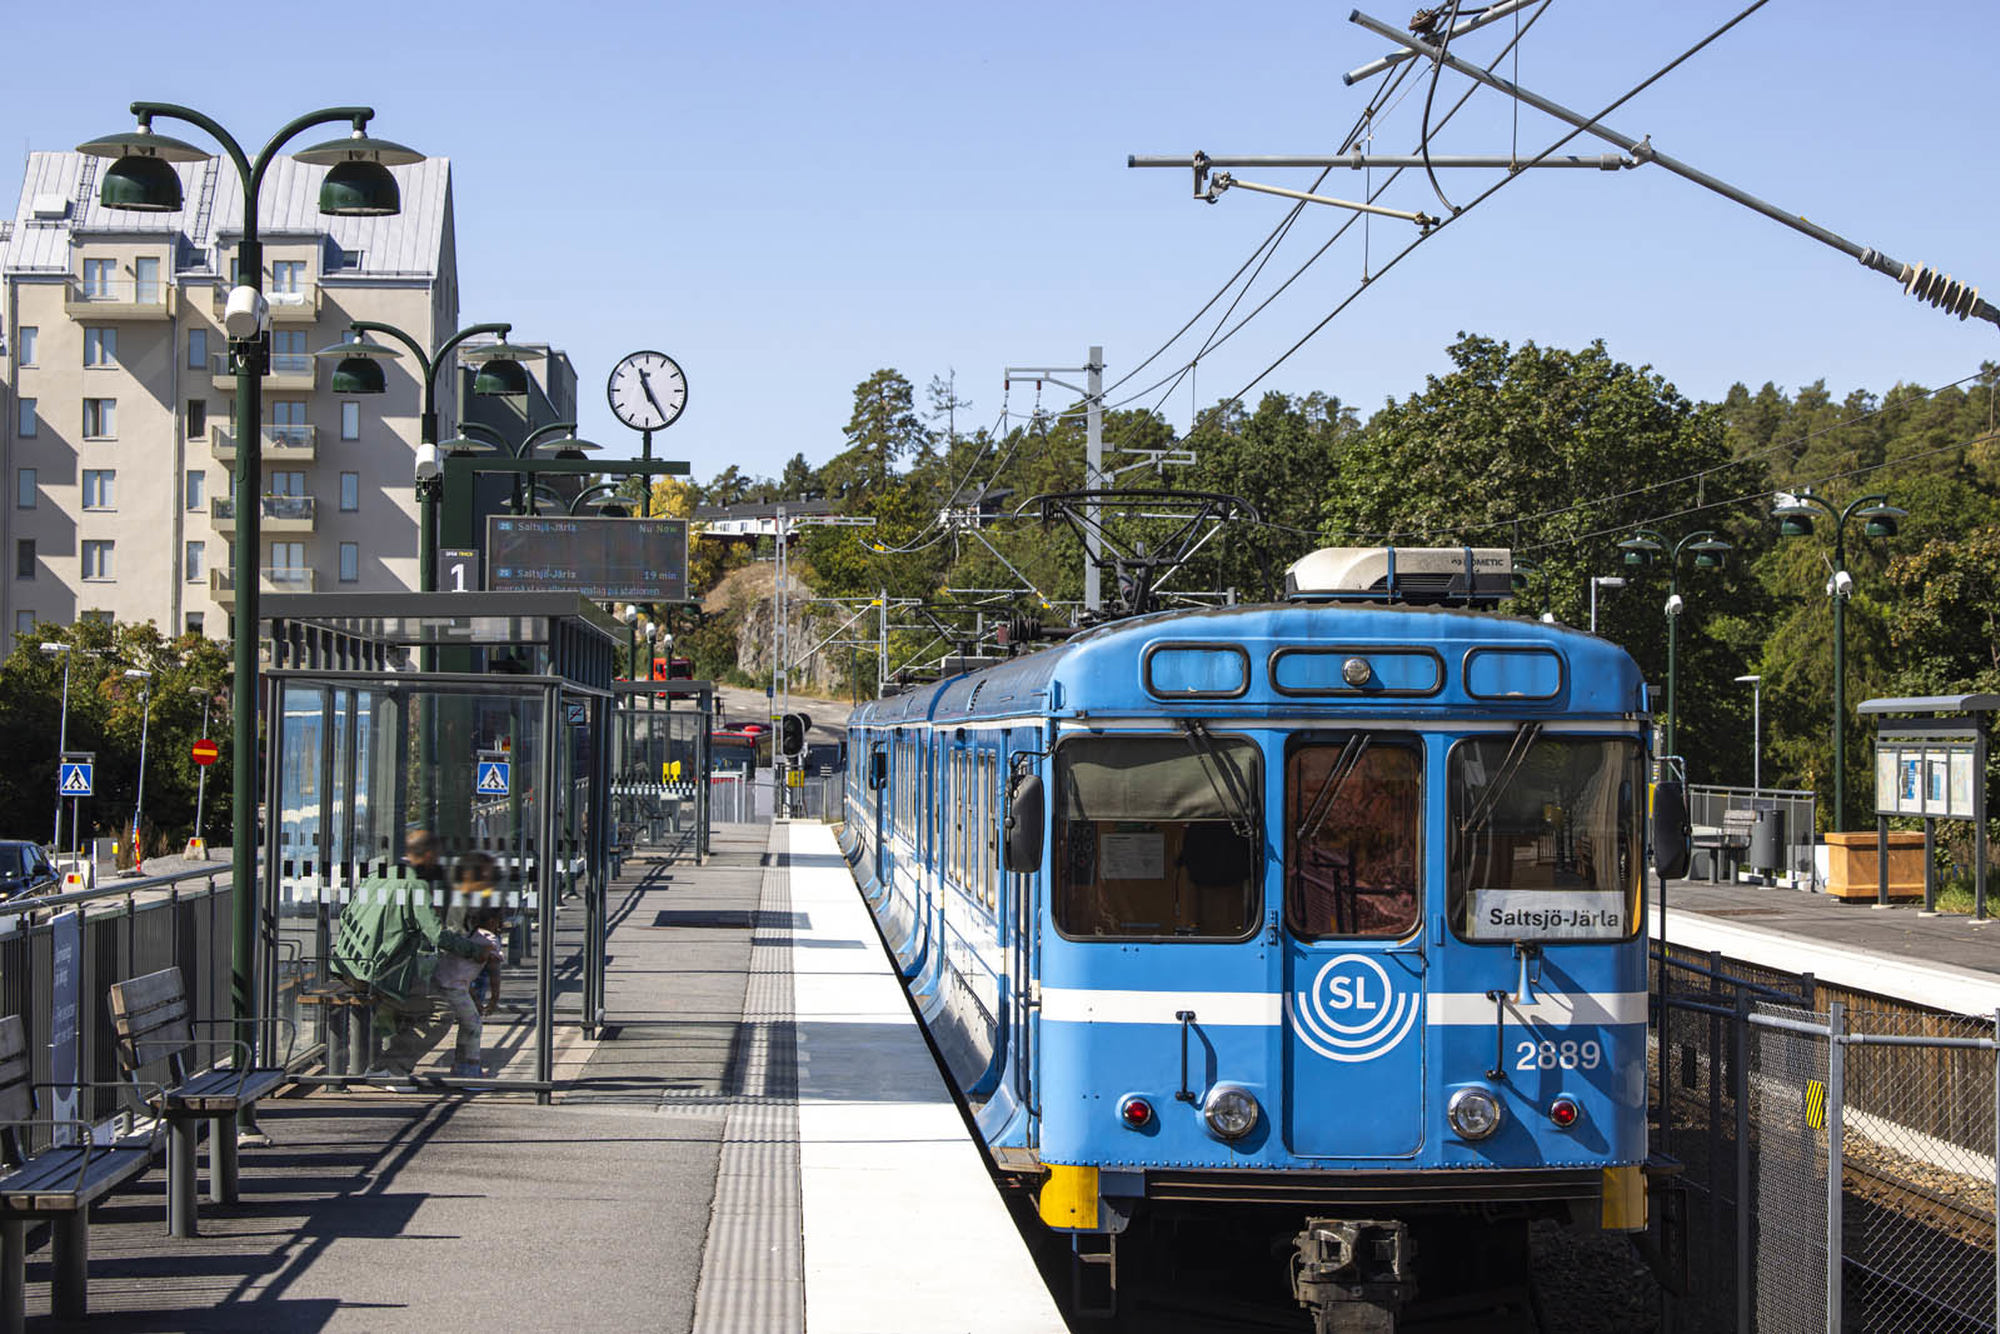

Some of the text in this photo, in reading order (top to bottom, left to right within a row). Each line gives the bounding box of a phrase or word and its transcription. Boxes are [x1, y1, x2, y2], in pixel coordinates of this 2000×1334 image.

[451, 563, 468, 592] 1
[1489, 908, 1619, 930] Saltsjö-Järla
[1328, 976, 1376, 1009] SL
[1516, 1040, 1600, 1071] 2889
